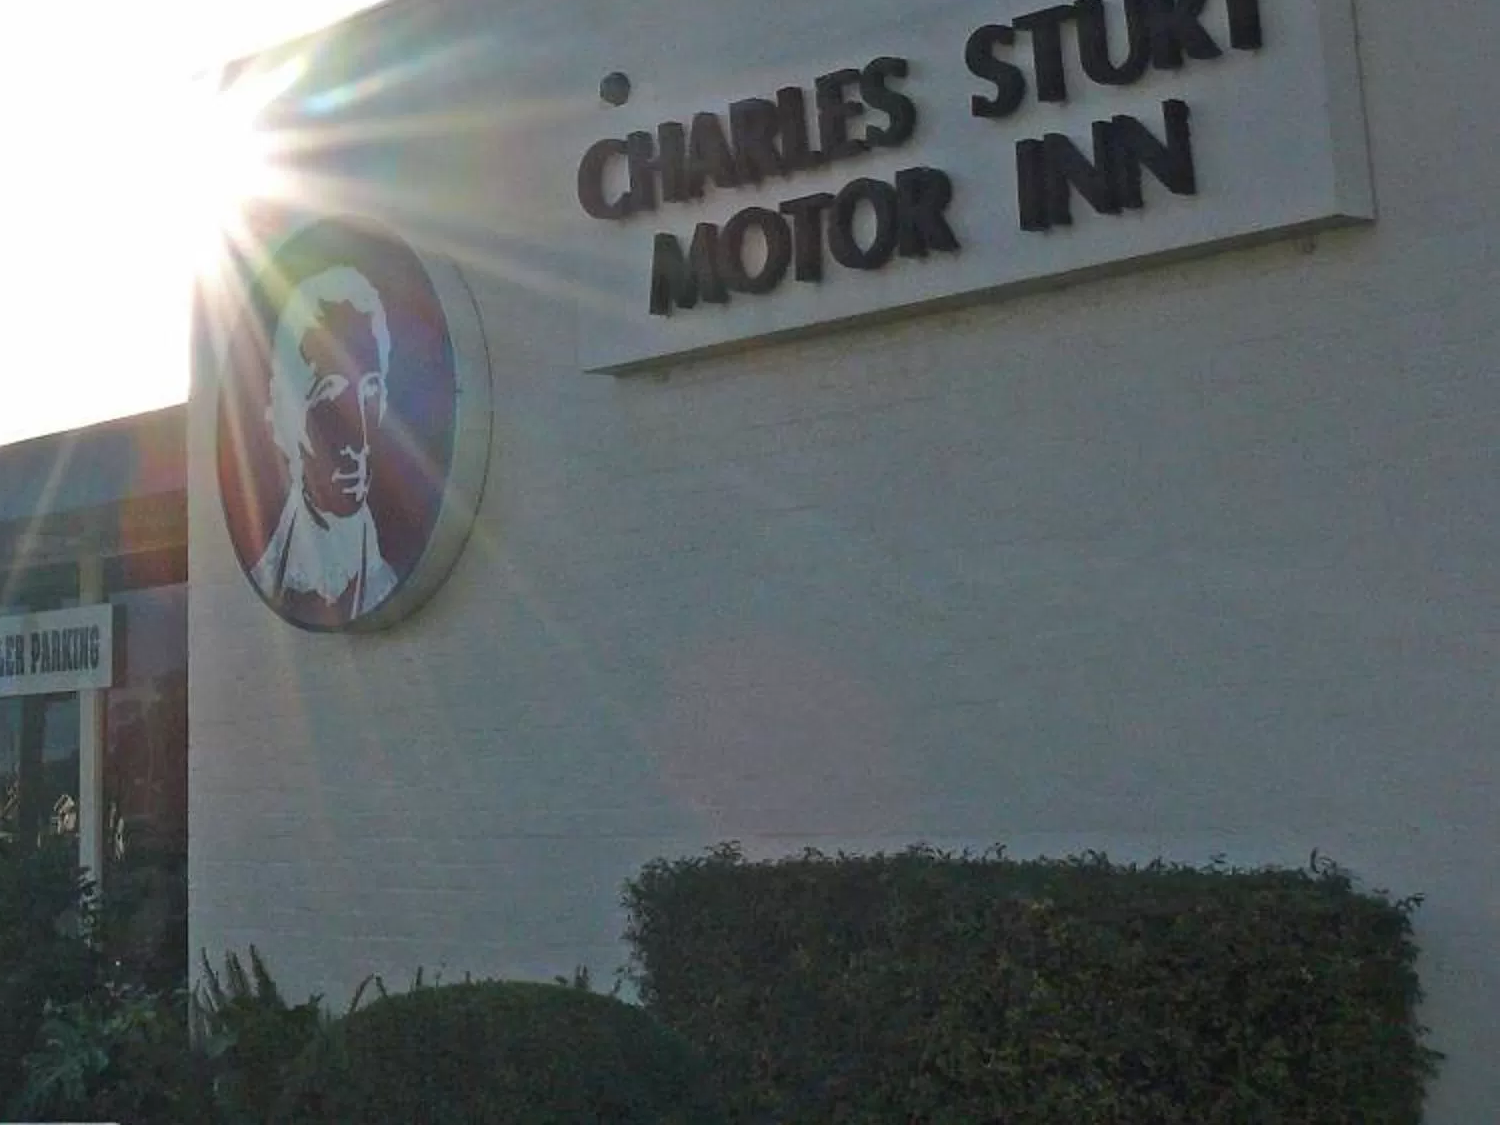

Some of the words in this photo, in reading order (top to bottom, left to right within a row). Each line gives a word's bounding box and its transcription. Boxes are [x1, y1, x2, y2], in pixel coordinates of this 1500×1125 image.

[577, 56, 918, 220] CHARLES
[649, 166, 962, 317] MOTOR
[1016, 99, 1197, 232] INN
[31, 625, 100, 674] PARKING
